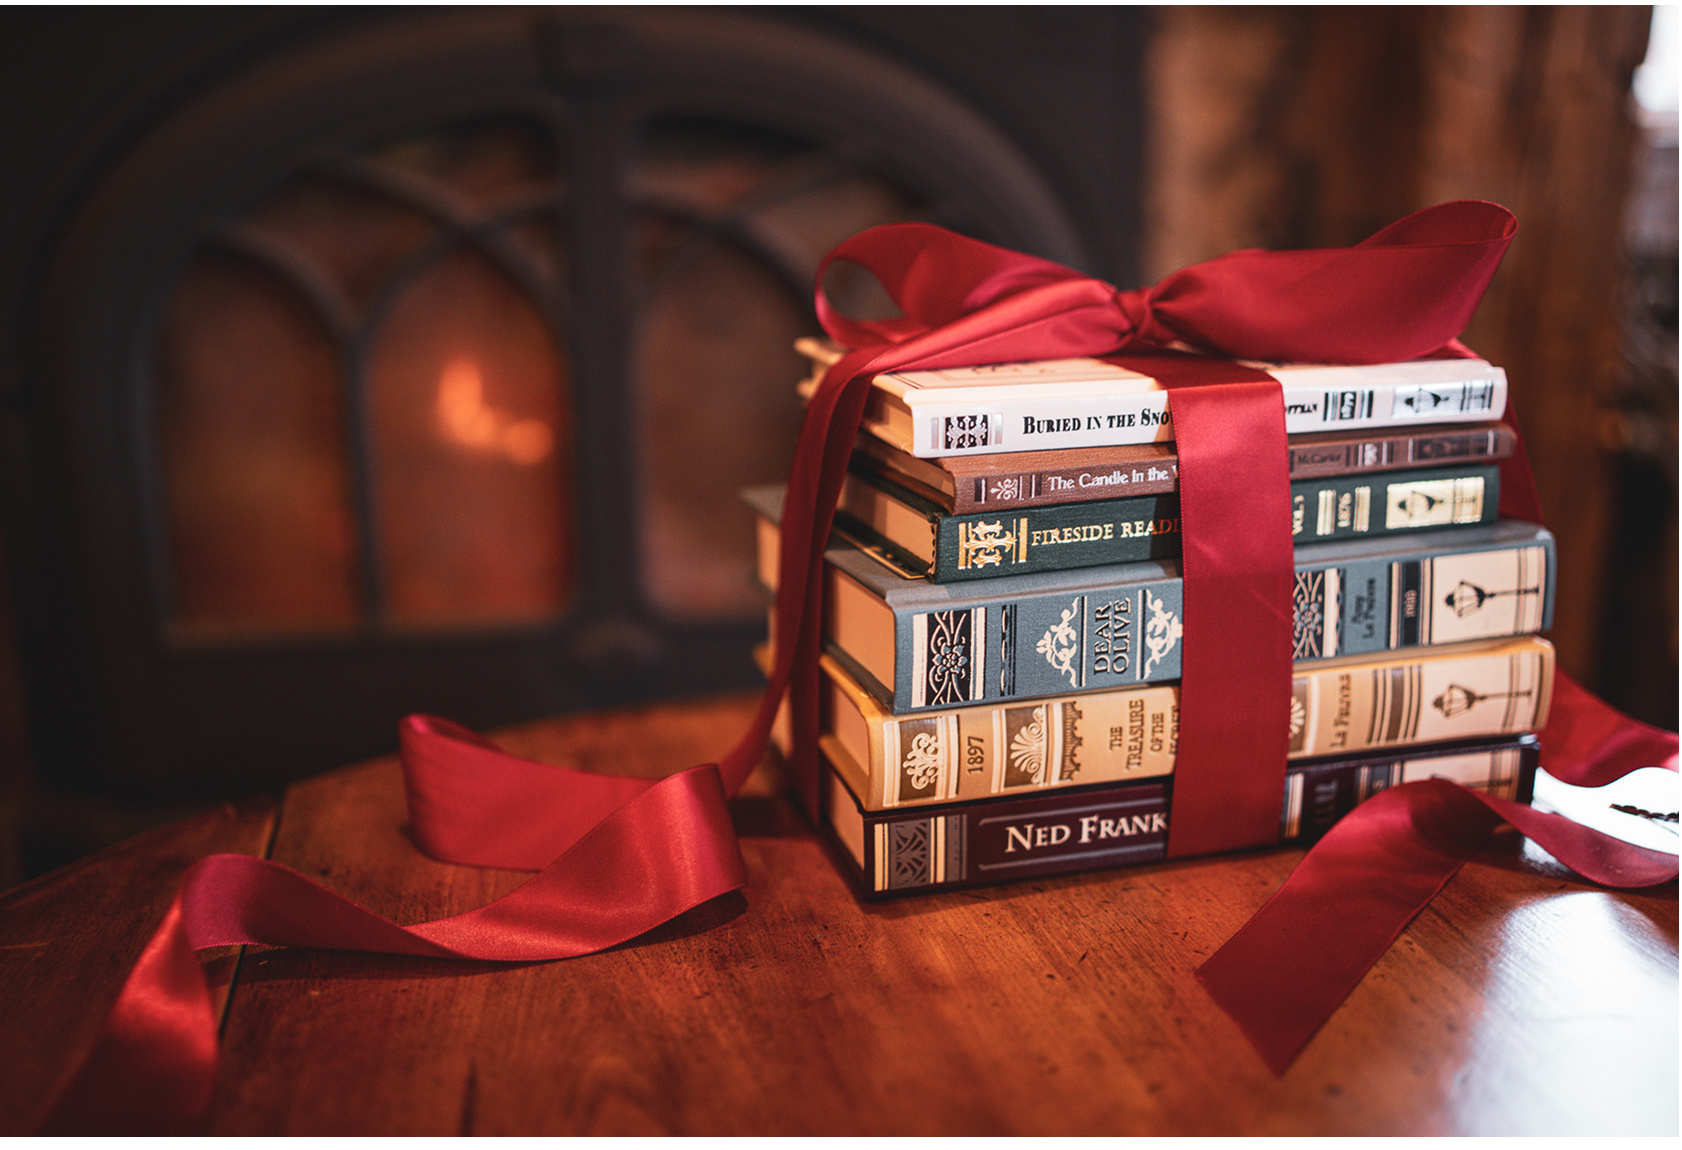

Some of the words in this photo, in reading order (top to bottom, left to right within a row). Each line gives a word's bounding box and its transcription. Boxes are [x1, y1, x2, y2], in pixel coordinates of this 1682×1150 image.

[1022, 415, 1081, 434] BURIED
[1087, 415, 1101, 430] IN
[1107, 413, 1136, 429] THE
[1047, 475, 1075, 492] The
[1078, 469, 1129, 488] Candle
[1131, 469, 1145, 483] In
[1147, 466, 1170, 482] the
[1031, 522, 1114, 547] FIRESIDE
[1093, 601, 1113, 676] DEAR
[1113, 597, 1132, 674] OLIVE
[1125, 699, 1144, 771] TREASURE
[1151, 712, 1164, 737] THE
[1109, 726, 1123, 751] THE
[1149, 737, 1163, 753] OF
[967, 736, 985, 775] 1897
[1005, 824, 1072, 853] NED
